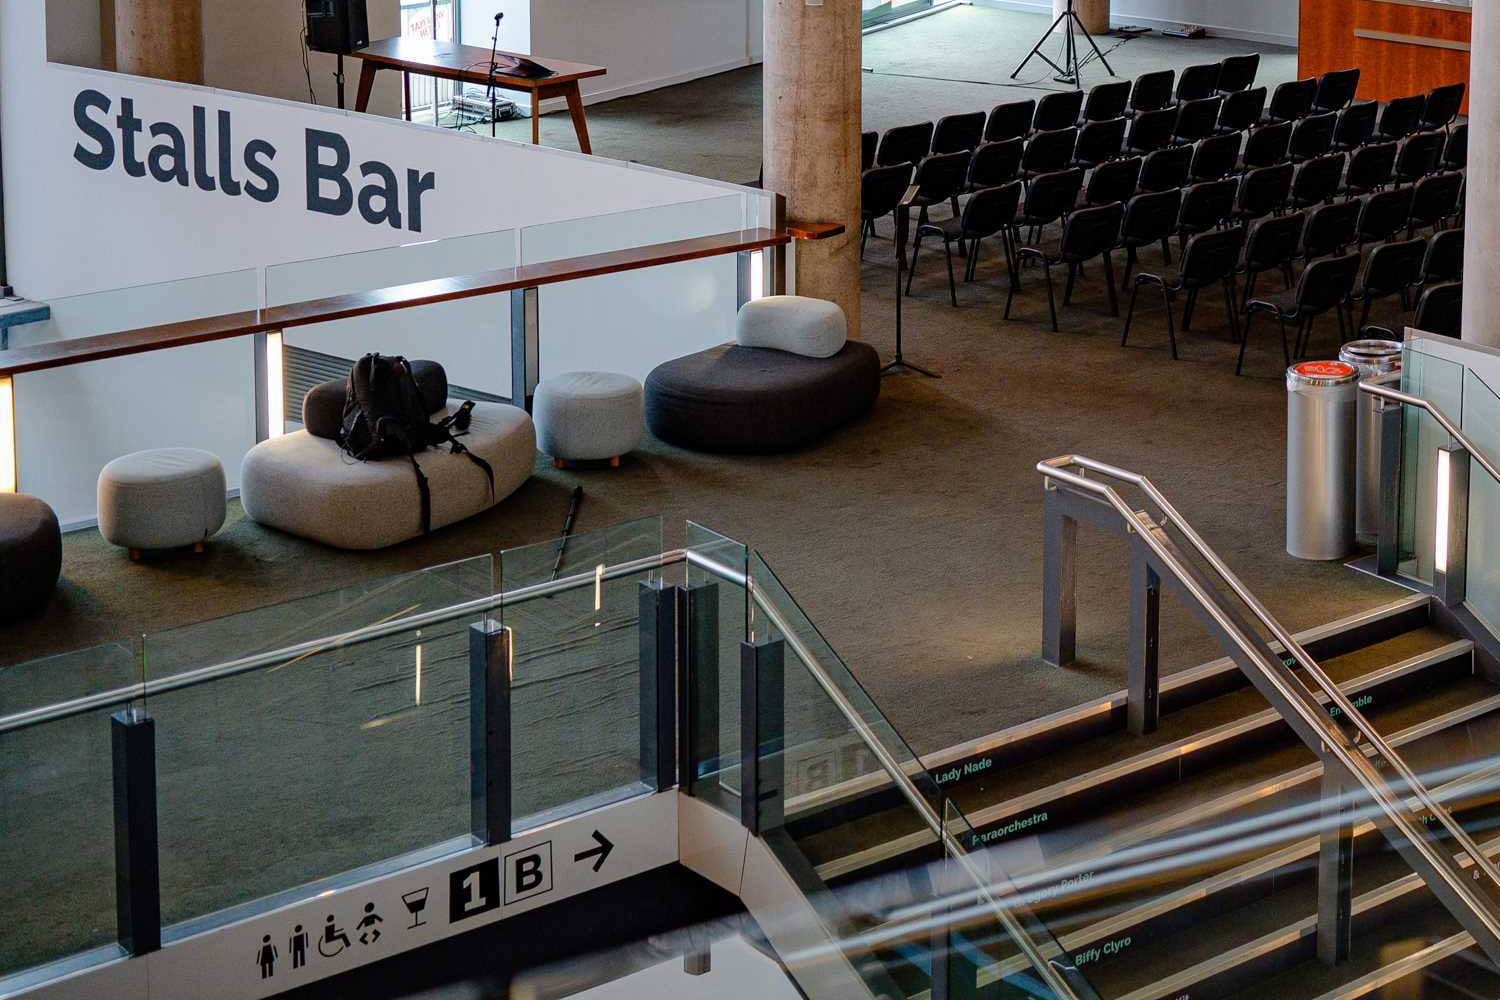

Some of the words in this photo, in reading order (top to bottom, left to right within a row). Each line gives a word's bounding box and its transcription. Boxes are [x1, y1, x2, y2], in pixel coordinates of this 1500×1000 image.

[73, 88, 280, 203] Stalls
[305, 127, 435, 233] Bar
[1329, 695, 1373, 717] Enmble
[935, 767, 962, 784] Lady
[964, 757, 992, 775] Nade
[971, 811, 1048, 846] Paraorchestra
[462, 871, 487, 912] 1
[514, 854, 543, 894] B
[1075, 949, 1101, 967] Biffy
[1103, 936, 1132, 955] Clyro
